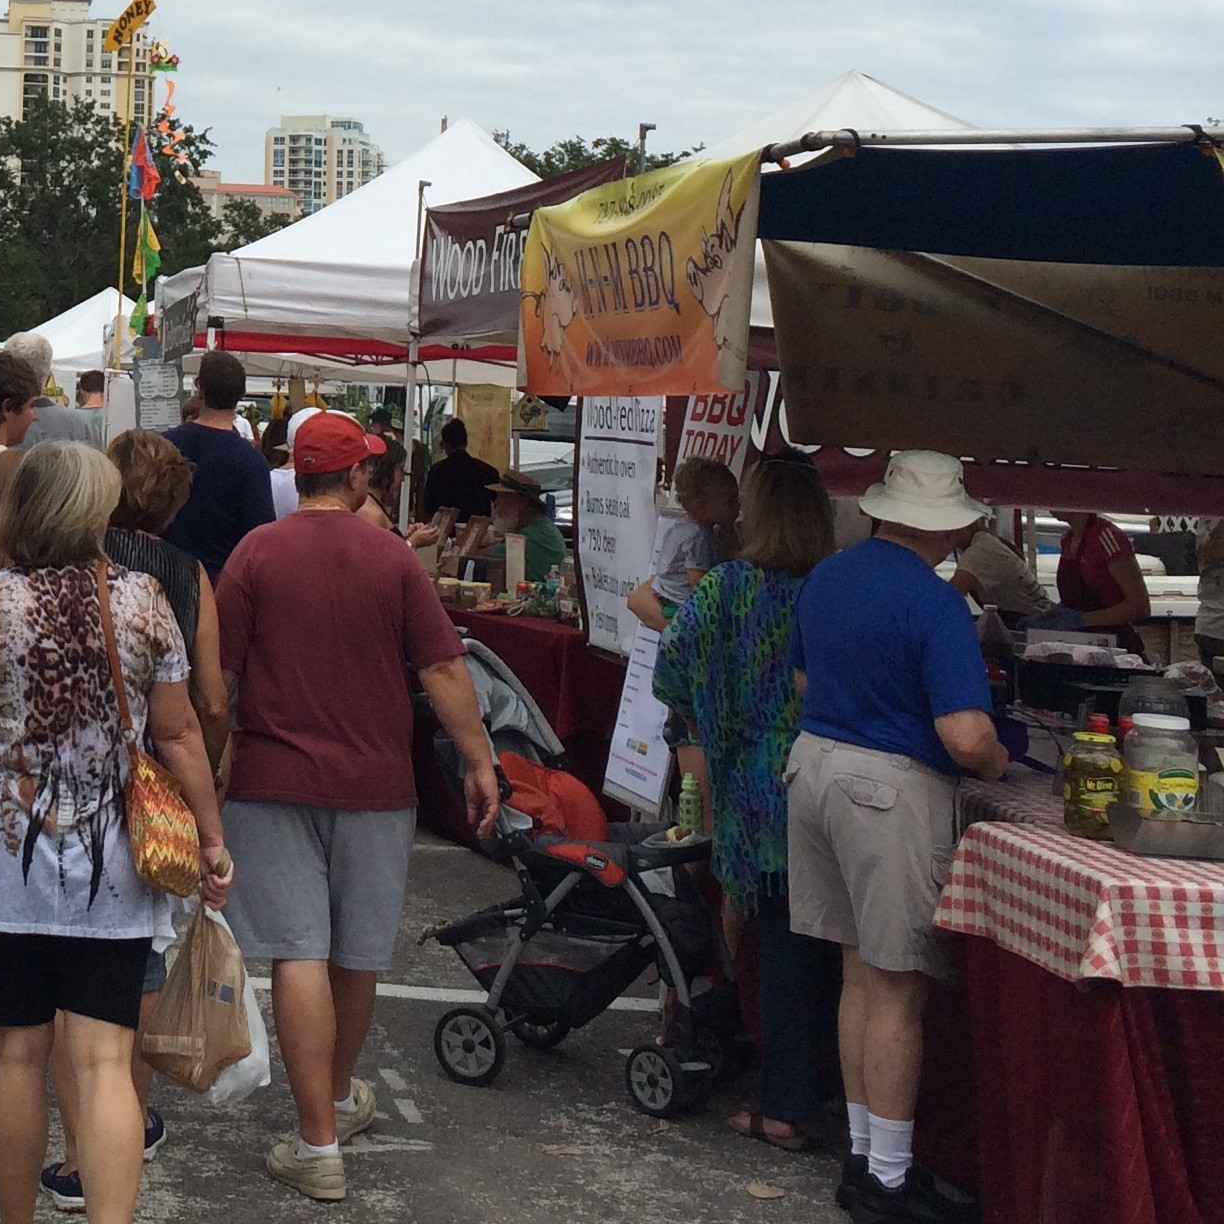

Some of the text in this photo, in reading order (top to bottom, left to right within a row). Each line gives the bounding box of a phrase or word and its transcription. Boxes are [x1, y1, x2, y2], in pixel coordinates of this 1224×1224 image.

[113, 0, 151, 46] HONEY
[431, 235, 487, 302] WOOD
[625, 230, 681, 317] BBQ
[690, 383, 751, 426] BBQ
[683, 428, 744, 465] TODAY
[588, 527, 602, 552] 750
